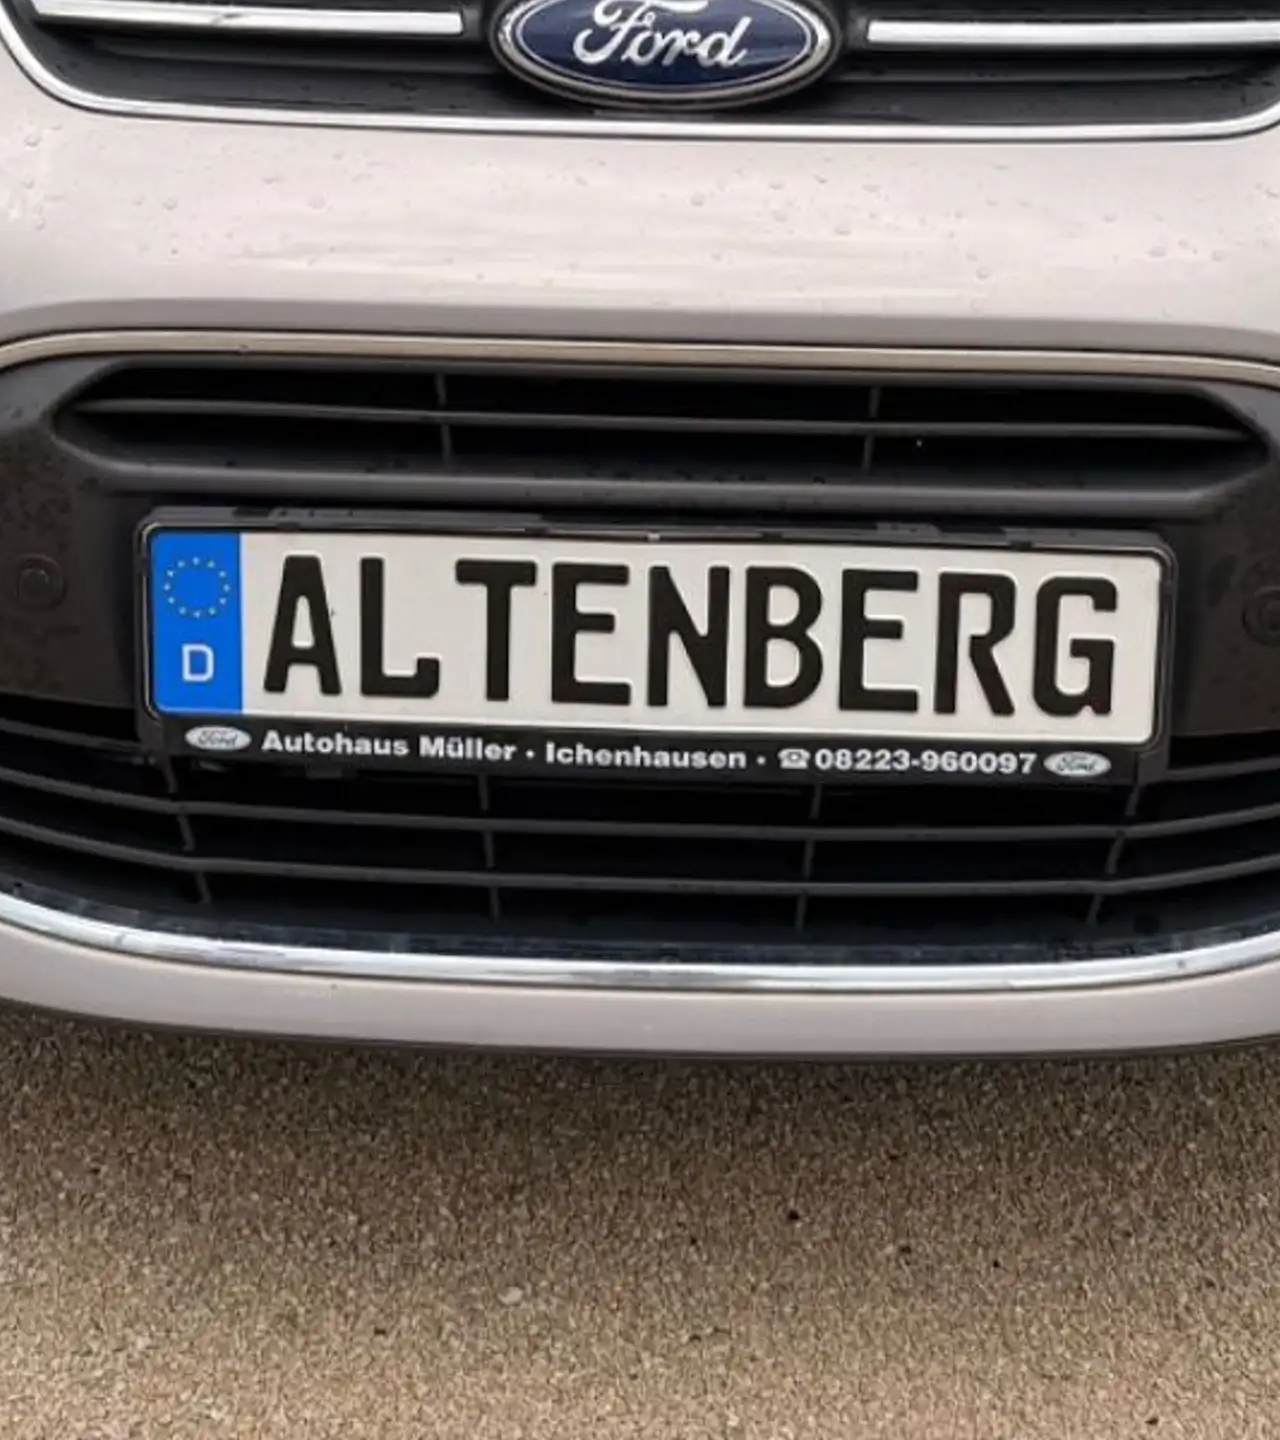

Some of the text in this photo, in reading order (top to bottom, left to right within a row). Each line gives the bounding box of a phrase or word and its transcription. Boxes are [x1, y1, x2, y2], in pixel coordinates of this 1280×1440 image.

[263, 555, 1118, 717] ALTENBERG
[181, 644, 214, 682] D
[261, 729, 409, 757] Autohaus
[419, 734, 517, 762] Müller
[546, 741, 747, 769] Ichenhausen
[815, 748, 1037, 775] 08223-960097
